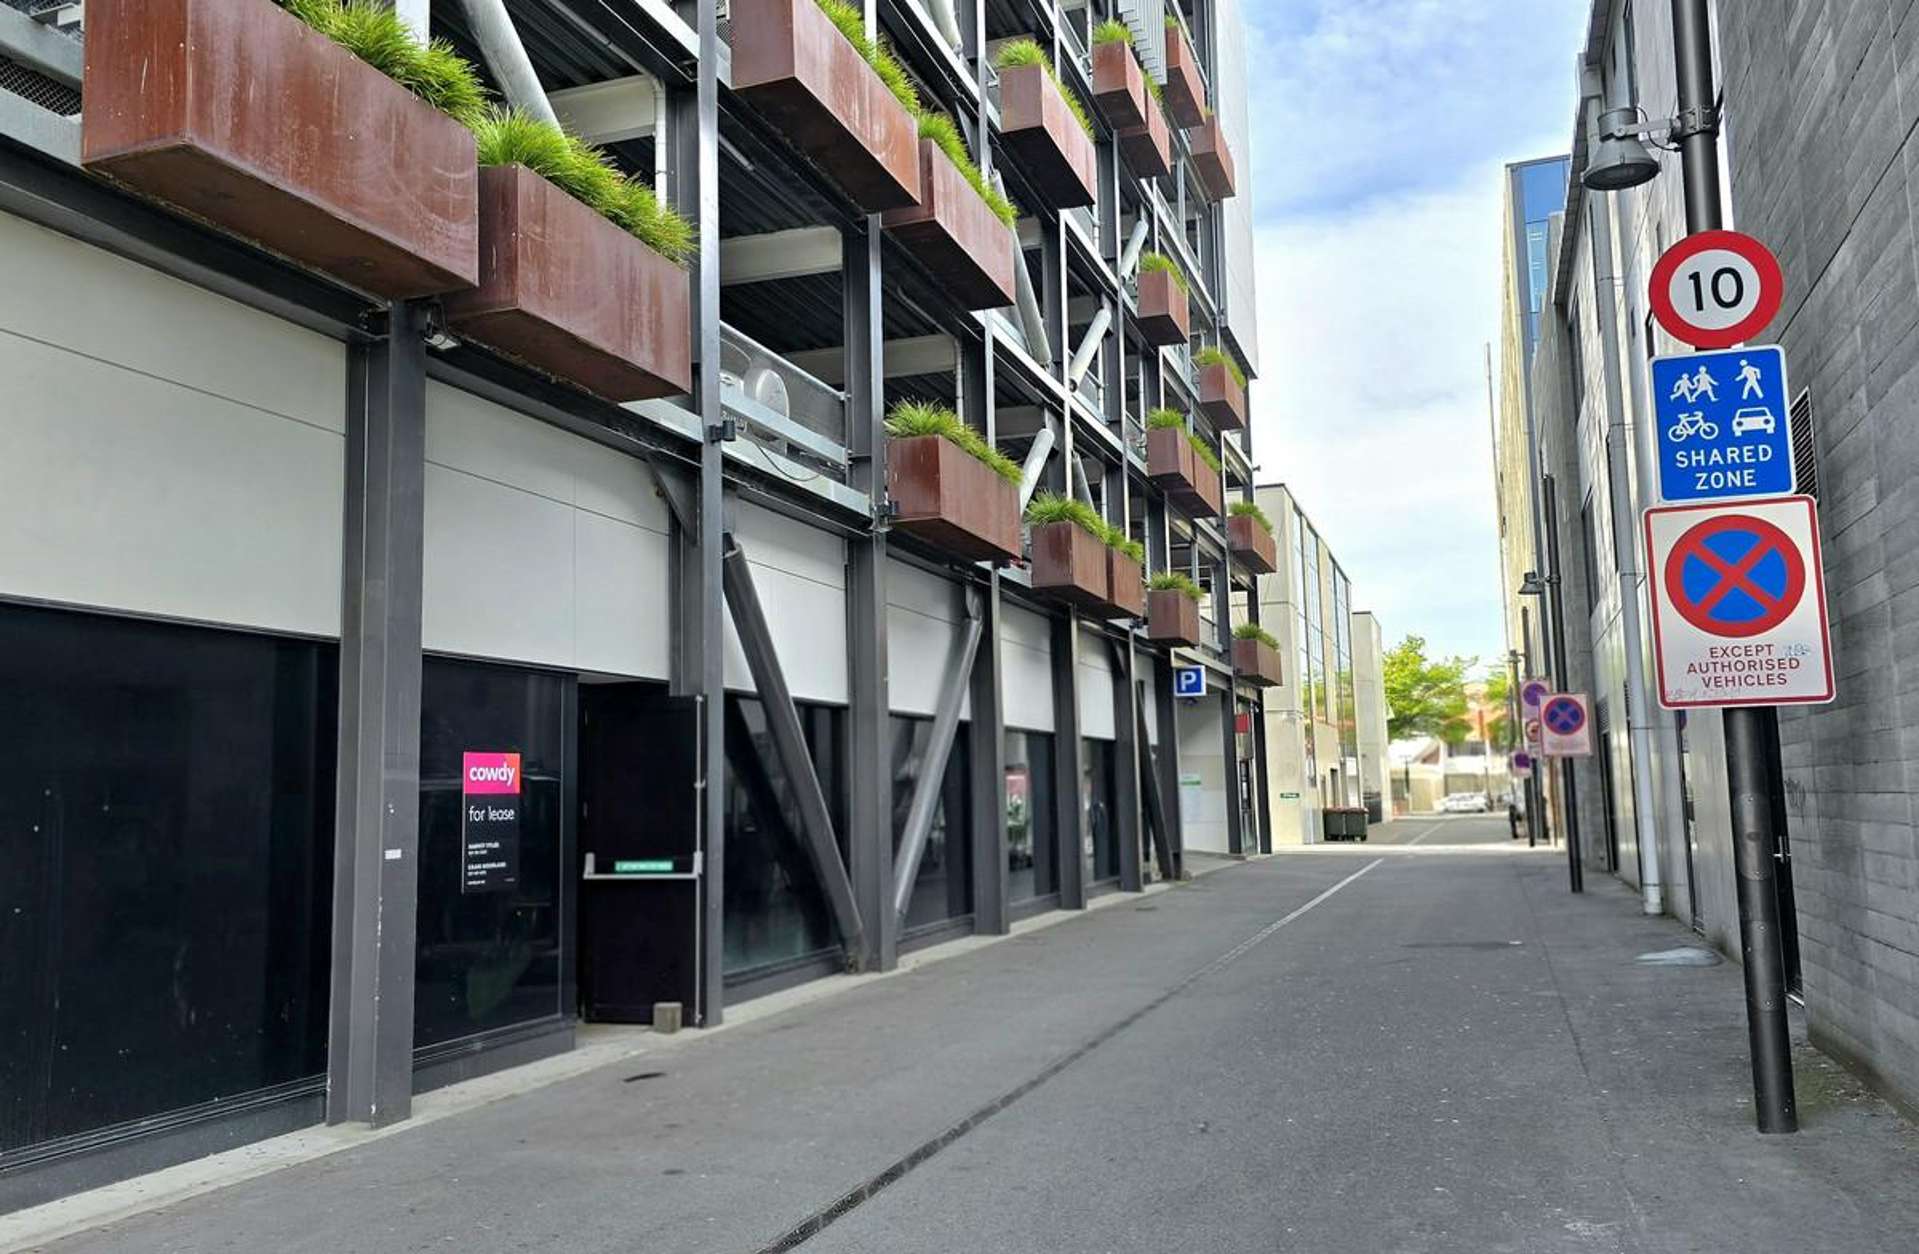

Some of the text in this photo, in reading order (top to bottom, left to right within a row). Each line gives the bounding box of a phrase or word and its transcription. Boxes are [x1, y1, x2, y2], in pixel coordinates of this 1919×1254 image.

[1688, 267, 1744, 311] 10
[1676, 445, 1772, 468] SHARED
[1696, 470, 1757, 489] ZONE
[1709, 644, 1775, 659] EXCEPT
[1687, 657, 1800, 674] AUTHORISED
[1180, 672, 1196, 691] P
[1702, 673, 1788, 688] VEHICLES
[469, 762, 515, 786] cowdy
[468, 806, 515, 822] for lease
